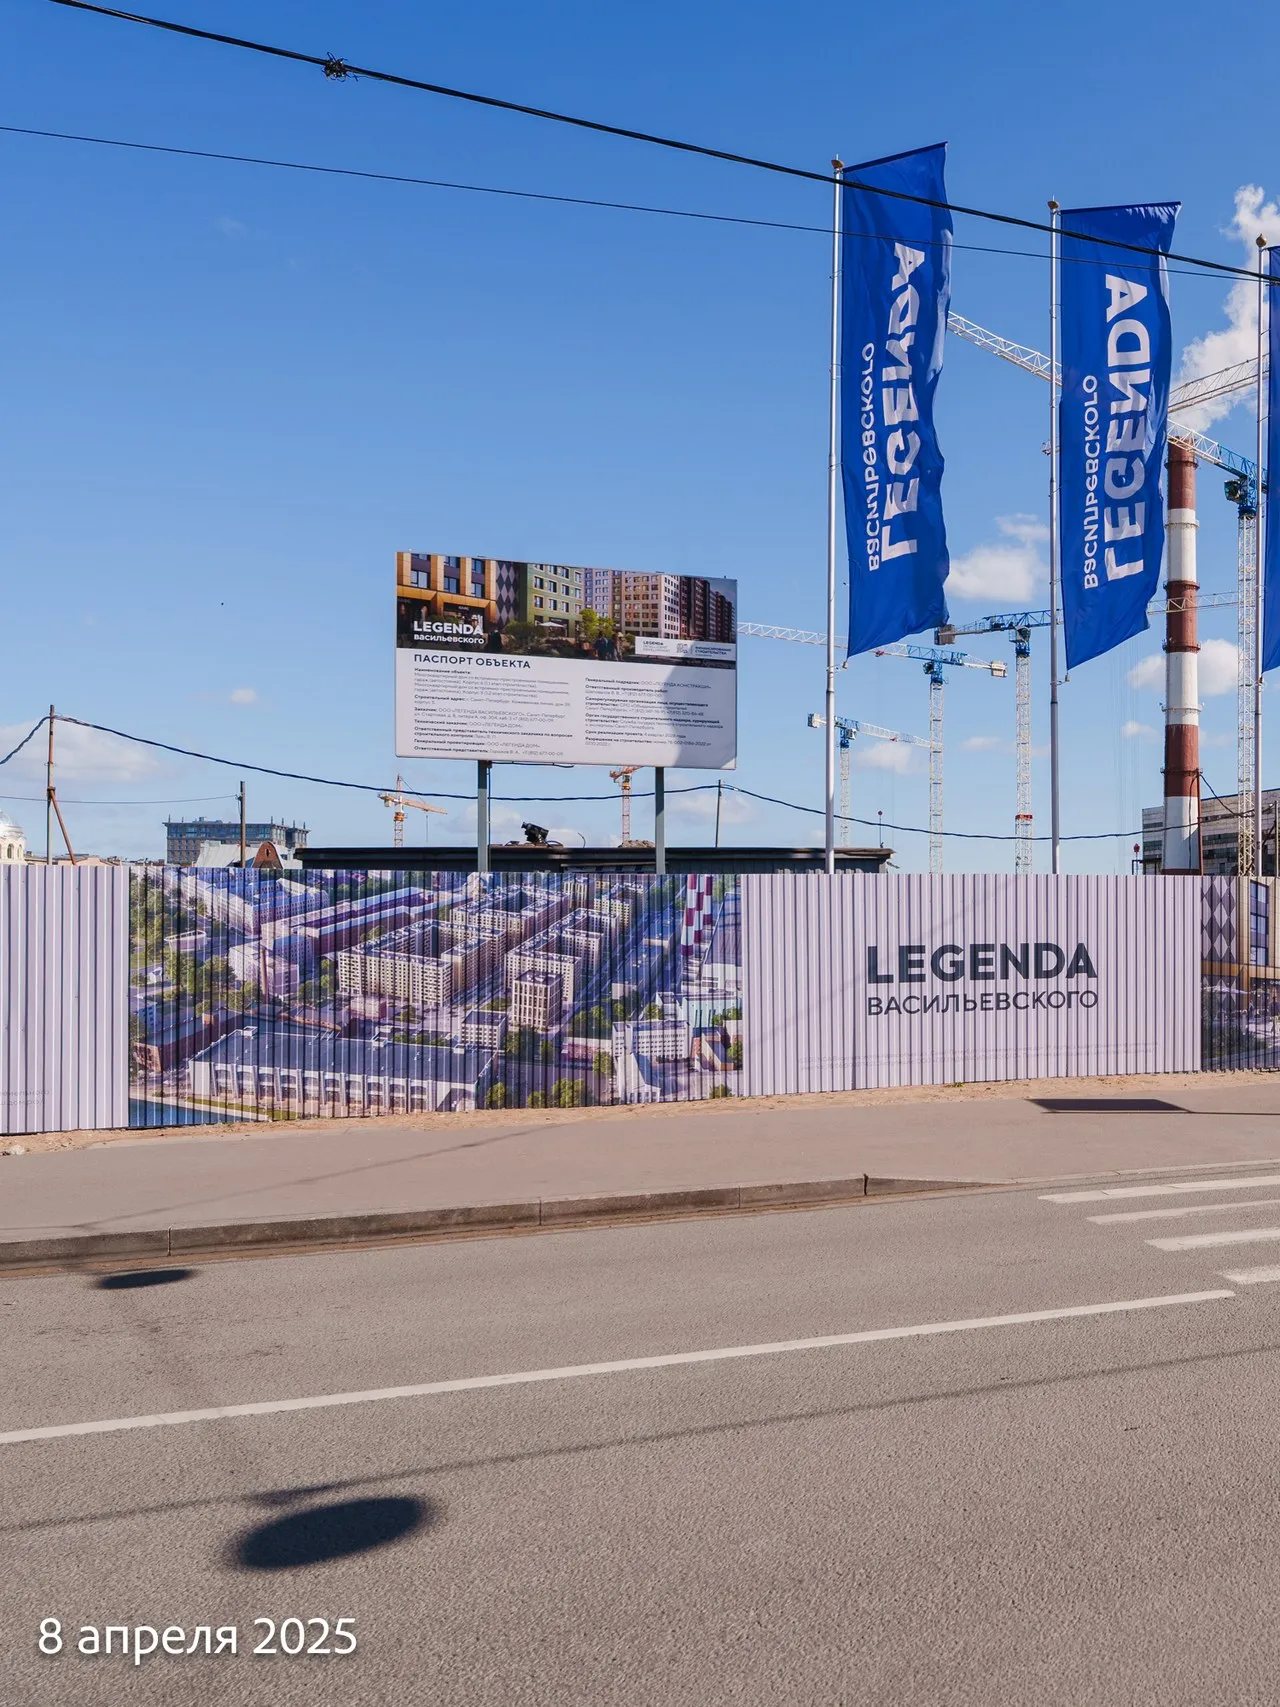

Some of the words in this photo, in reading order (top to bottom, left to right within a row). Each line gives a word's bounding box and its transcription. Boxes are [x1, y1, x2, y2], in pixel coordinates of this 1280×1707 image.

[413, 620, 484, 636] LEGENDA
[414, 653, 473, 665] ПАСПОРТ
[475, 657, 531, 669] ОБЪЕКТА
[867, 942, 1098, 985] LEGENDA
[867, 988, 1099, 1017] ВАСИЛЬЕВСКОГО
